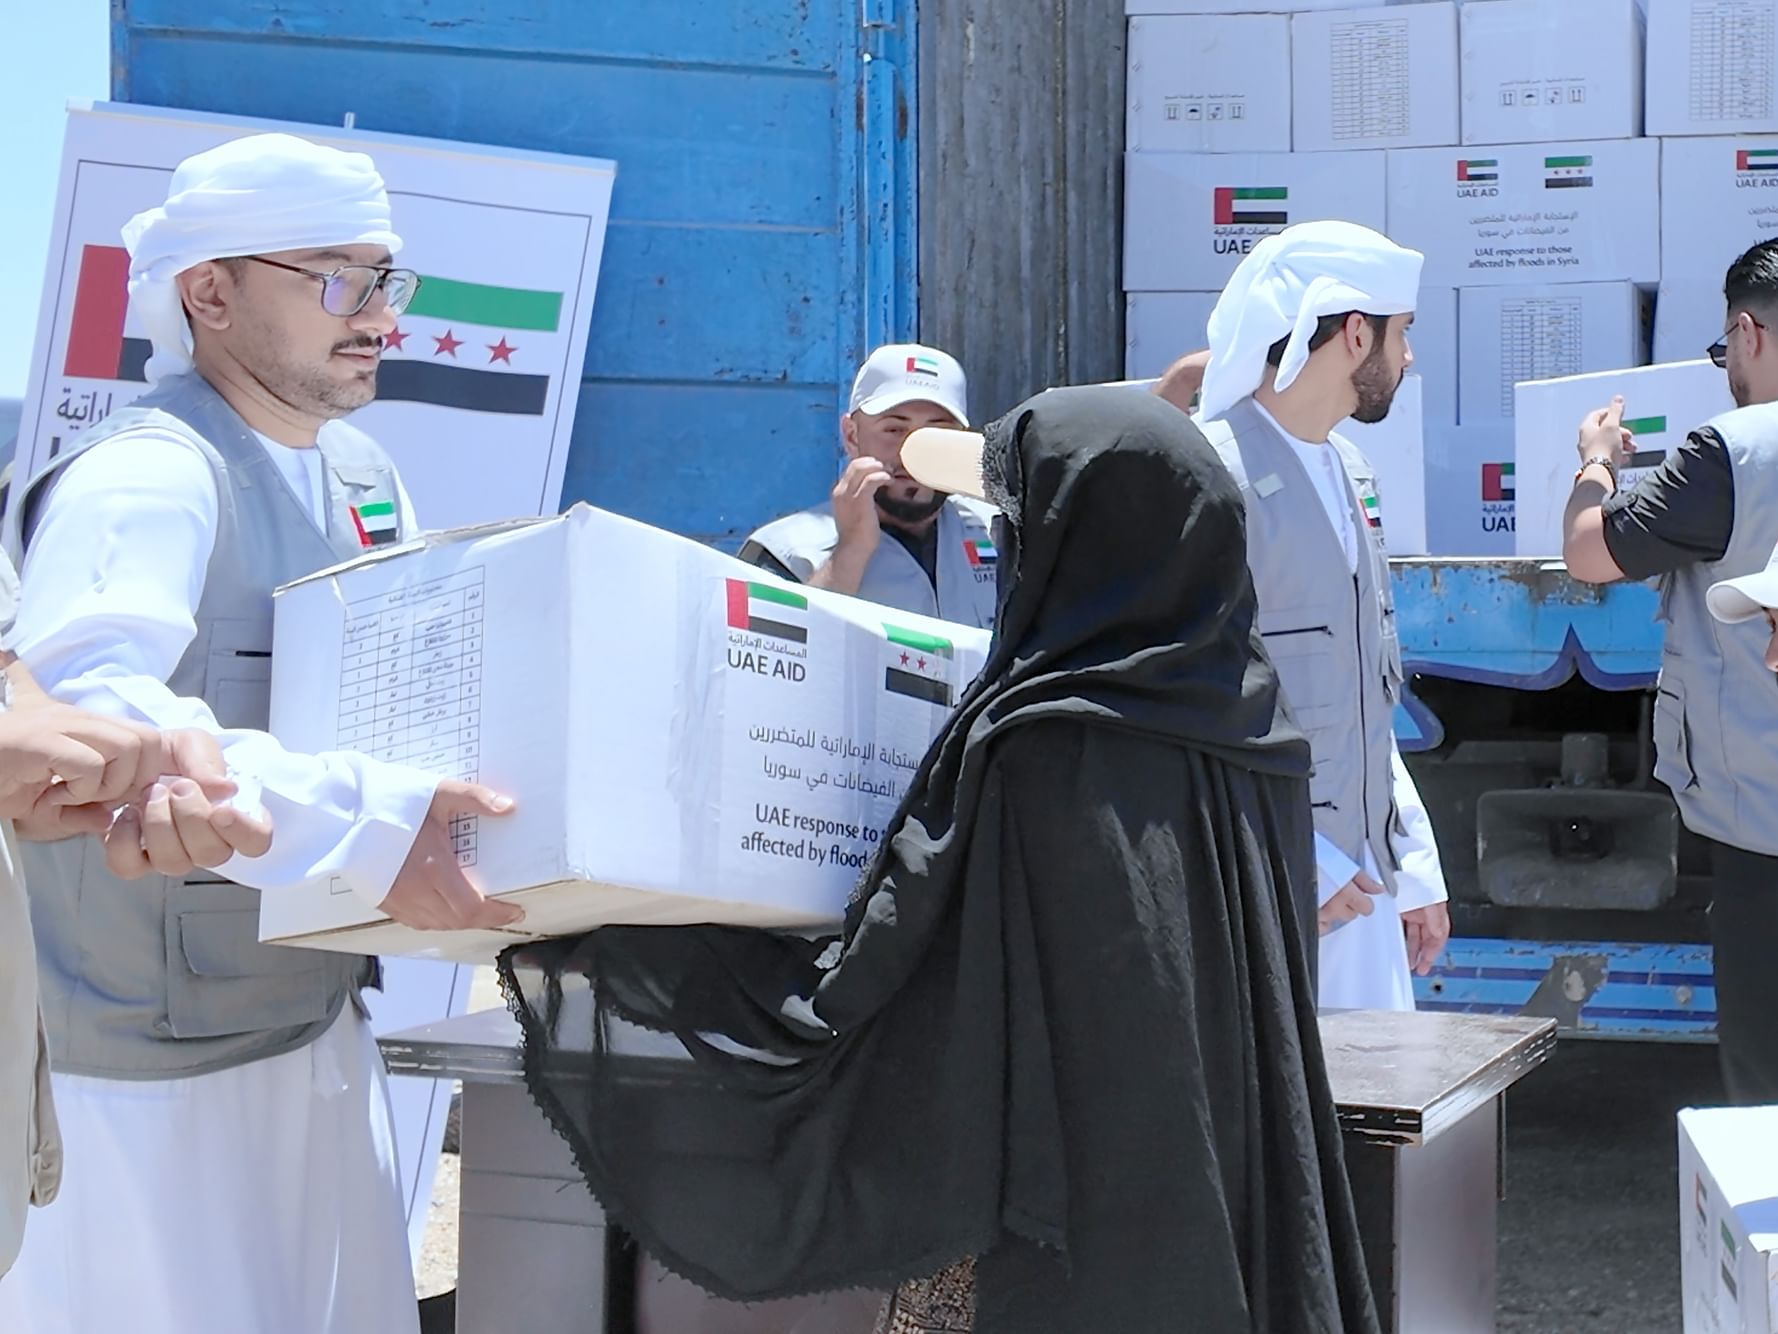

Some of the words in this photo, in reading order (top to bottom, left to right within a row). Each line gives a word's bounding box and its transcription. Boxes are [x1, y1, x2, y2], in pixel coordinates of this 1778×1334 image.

[1457, 189, 1480, 198] UAE
[1481, 188, 1499, 198] AID
[1213, 239, 1252, 254] UAE
[1475, 247, 1494, 256] UAE
[1496, 247, 1535, 258] response
[1536, 247, 1547, 255] to
[1548, 246, 1573, 254] those
[1468, 258, 1504, 268] affected
[1505, 258, 1517, 269] by
[1518, 257, 1545, 267] floods
[1547, 257, 1556, 266] in
[1557, 256, 1580, 268] Syria
[727, 648, 769, 676] UAE
[772, 659, 806, 683] AID
[749, 724, 816, 749] للمتضررين
[821, 735, 875, 765] الإماراتية
[764, 755, 801, 780] سوريا
[756, 803, 791, 828] UAE
[793, 815, 860, 839] response
[863, 825, 879, 843] to
[741, 831, 805, 859] affected
[808, 840, 827, 868] by
[830, 844, 868, 868] flood
